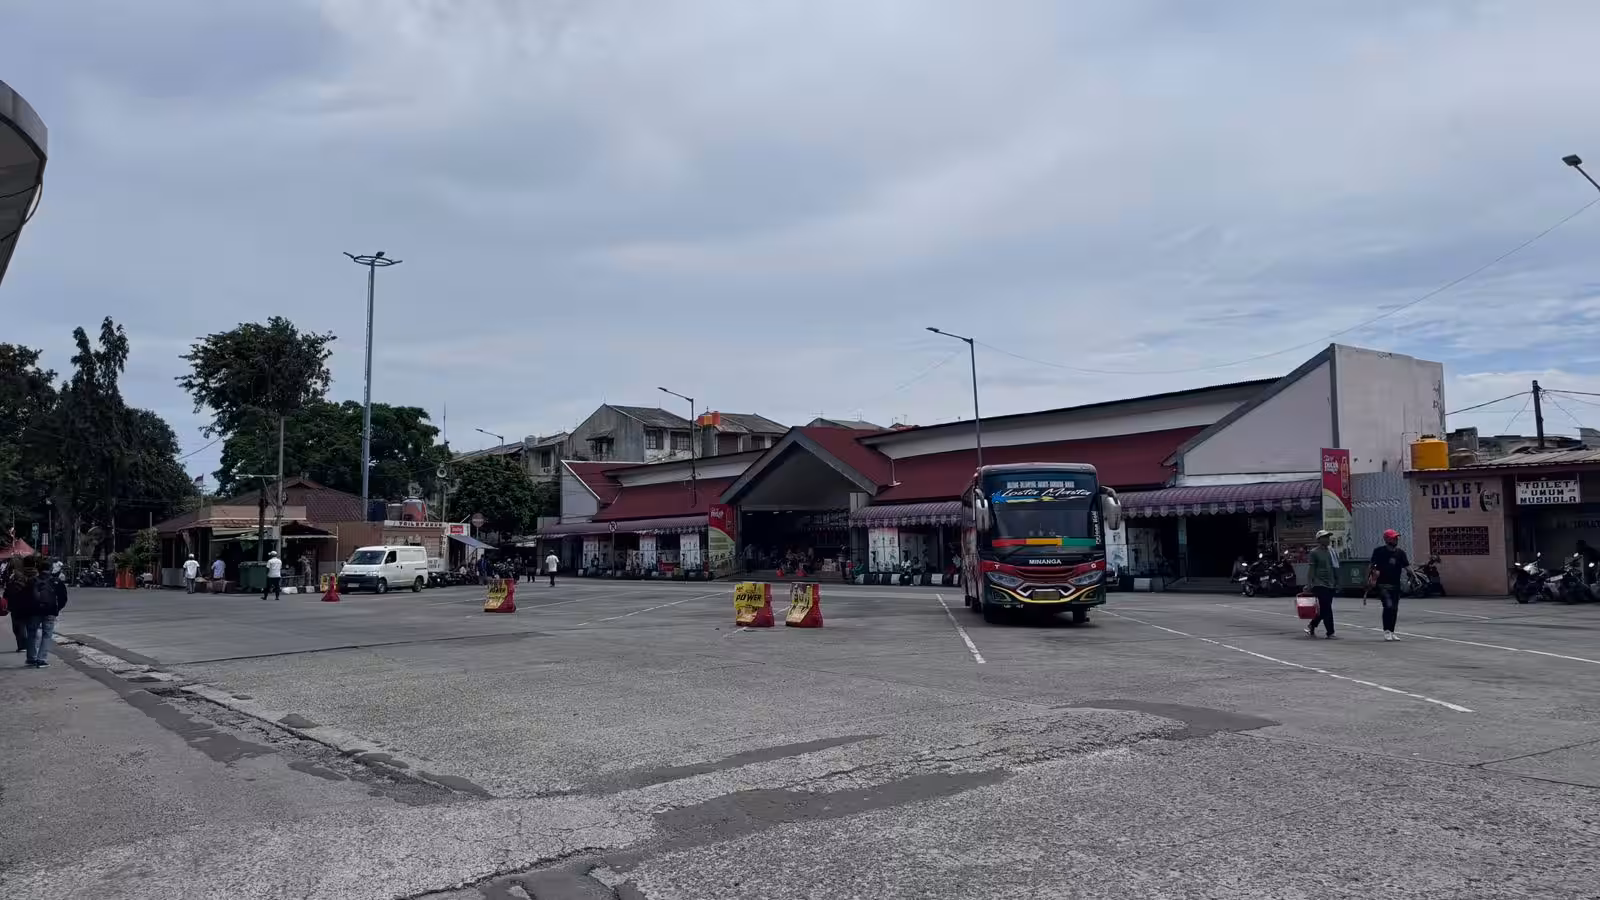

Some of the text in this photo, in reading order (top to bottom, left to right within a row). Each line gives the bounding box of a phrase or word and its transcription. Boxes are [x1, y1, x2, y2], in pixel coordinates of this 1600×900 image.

[1420, 482, 1482, 495] TOILET
[1524, 481, 1570, 489] TOILET
[1431, 496, 1471, 510] UMUM
[1520, 496, 1576, 504] MUSHOLA
[735, 593, 762, 602] POWER
